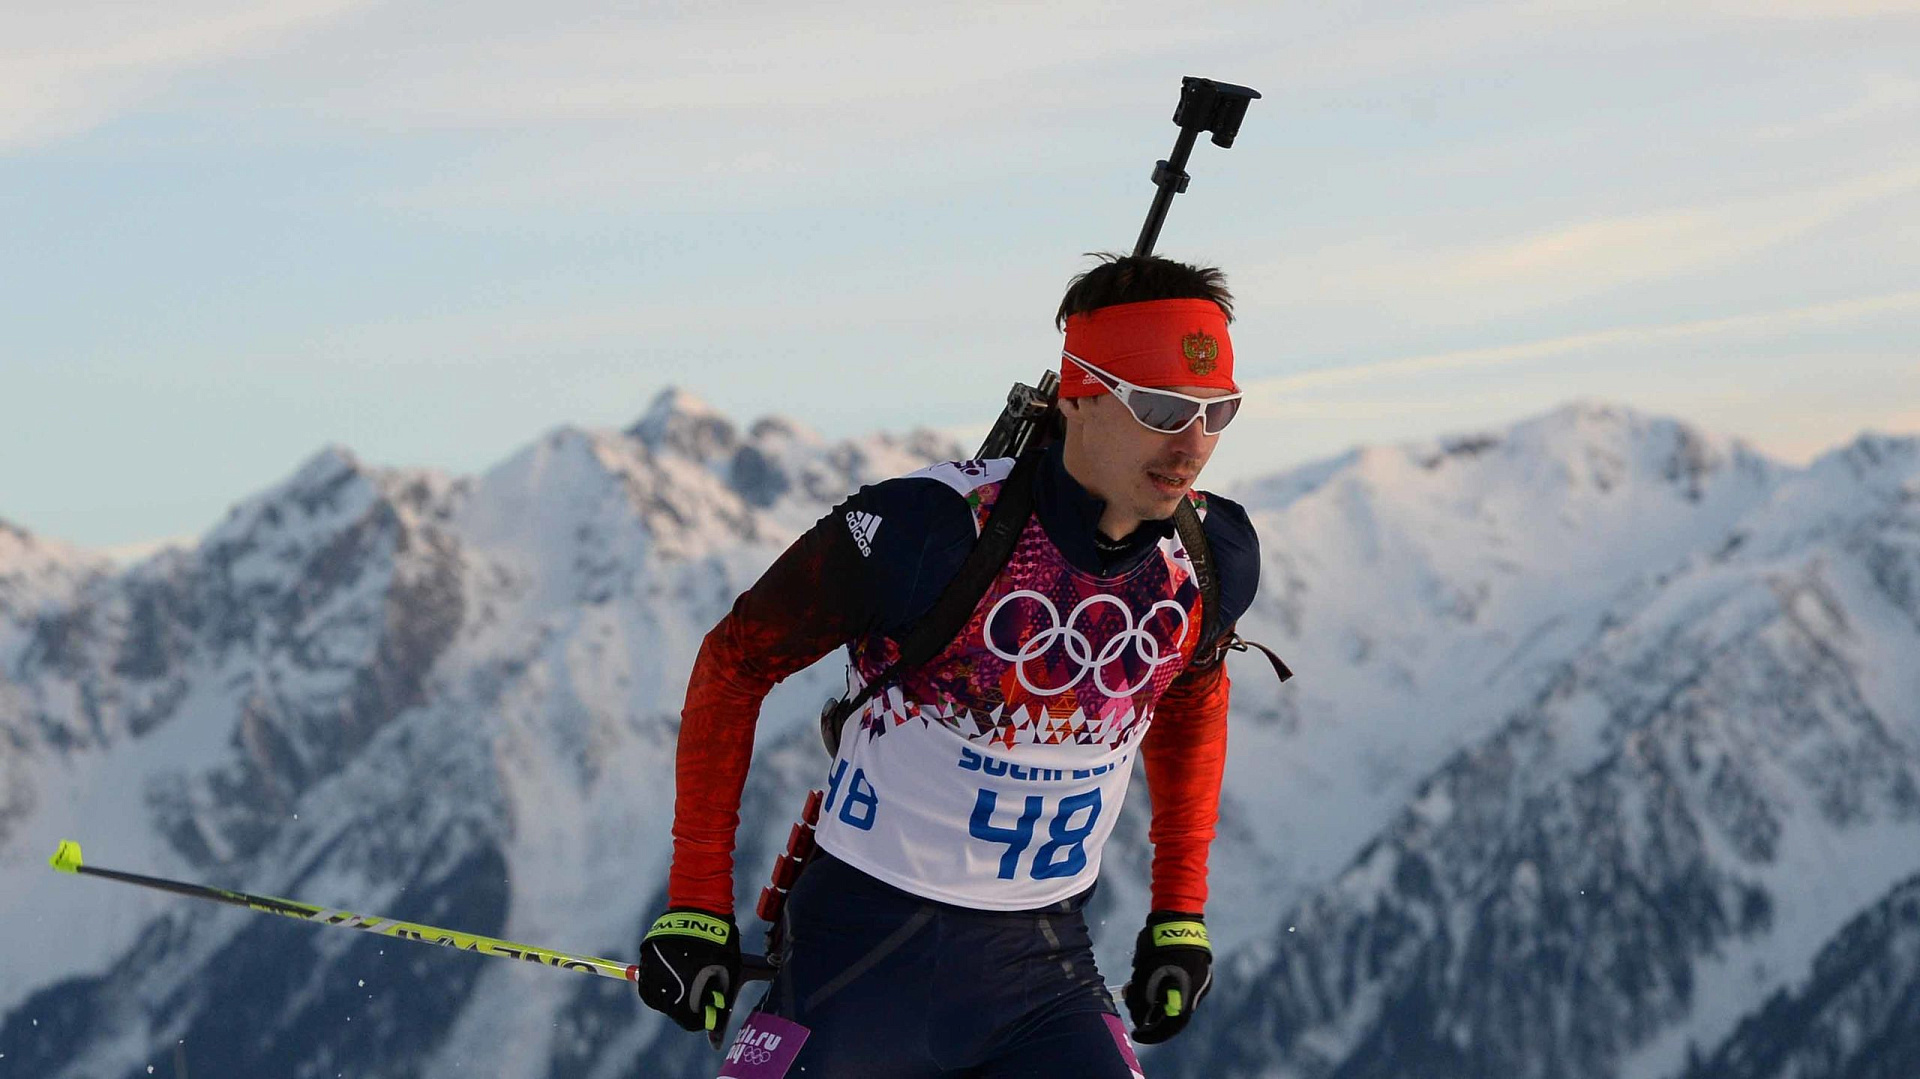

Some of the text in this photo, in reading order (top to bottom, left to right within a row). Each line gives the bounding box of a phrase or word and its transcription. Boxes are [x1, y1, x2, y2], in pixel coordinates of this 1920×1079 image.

[845, 510, 871, 558] adidas
[824, 757, 879, 831] 48
[967, 786, 1103, 880] 48
[653, 919, 727, 937] ONEW
